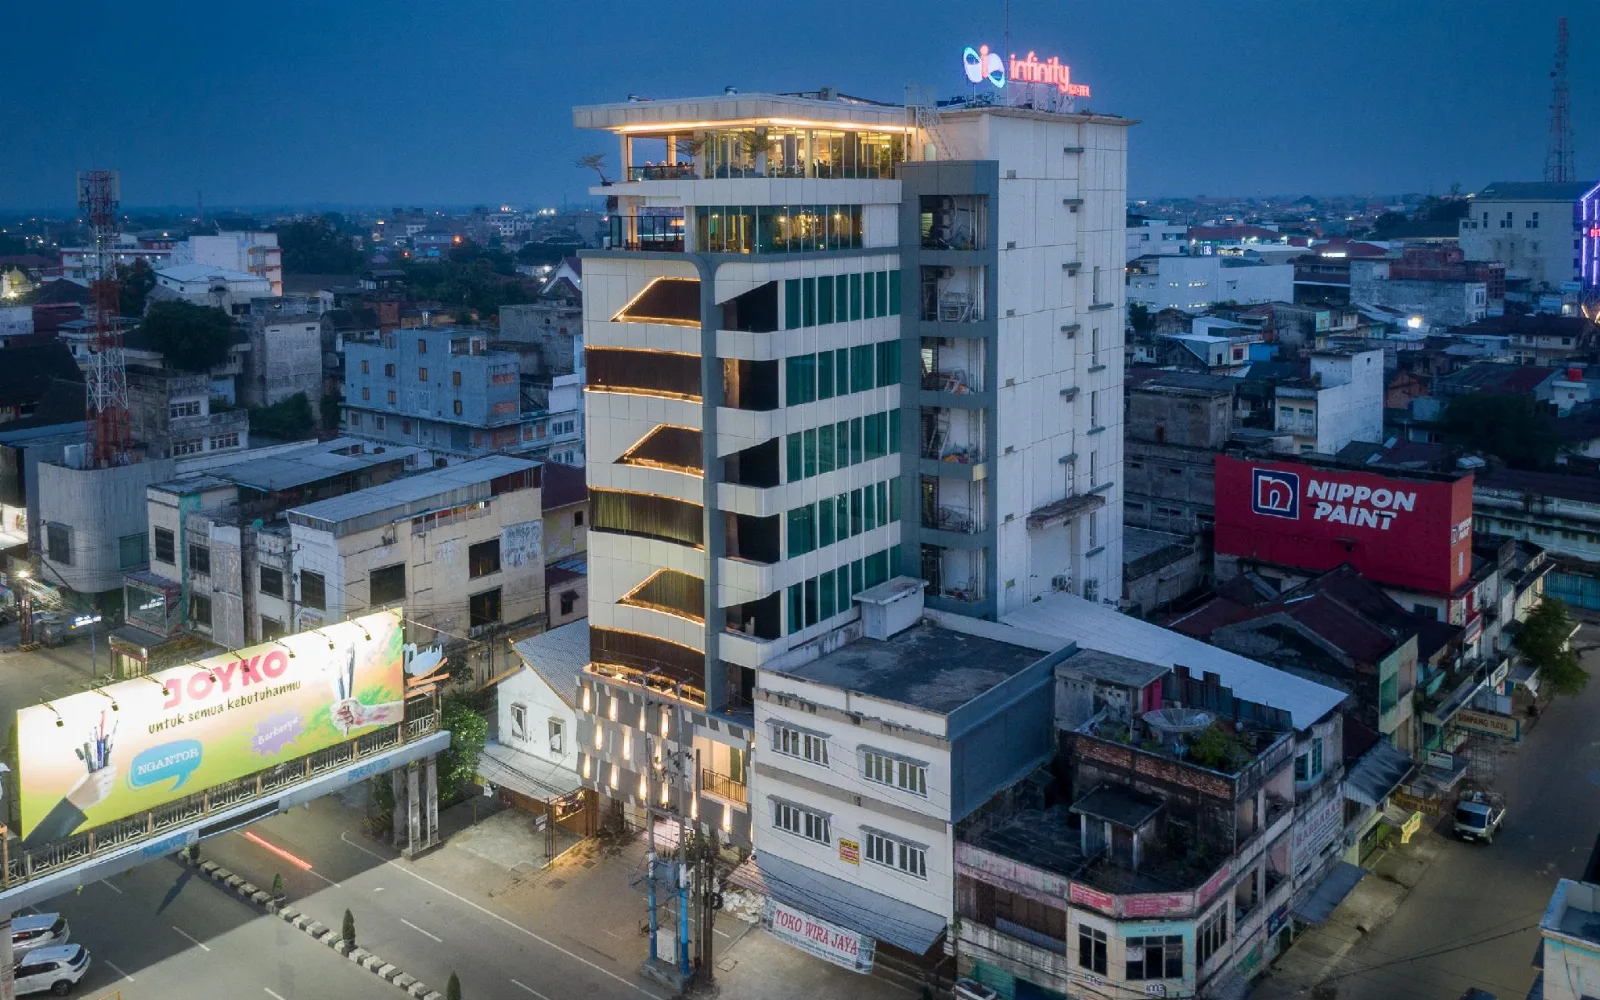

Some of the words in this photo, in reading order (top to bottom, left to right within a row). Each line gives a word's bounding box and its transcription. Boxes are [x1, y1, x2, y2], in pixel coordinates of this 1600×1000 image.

[1009, 51, 1069, 92] infinity
[1306, 479, 1416, 512] NIPPON
[1313, 501, 1397, 530] PAINT
[163, 650, 288, 710] JOYKO
[148, 713, 184, 733] untuk
[188, 703, 224, 722] semua
[227, 680, 301, 711] kebutuhanmu
[1458, 712, 1489, 728] SIMPANG
[1490, 720, 1509, 732] RAYA
[137, 748, 199, 775] NGANTOR
[775, 909, 803, 932] TOKO
[805, 922, 830, 945] WIRA
[831, 933, 858, 955] JAYA
